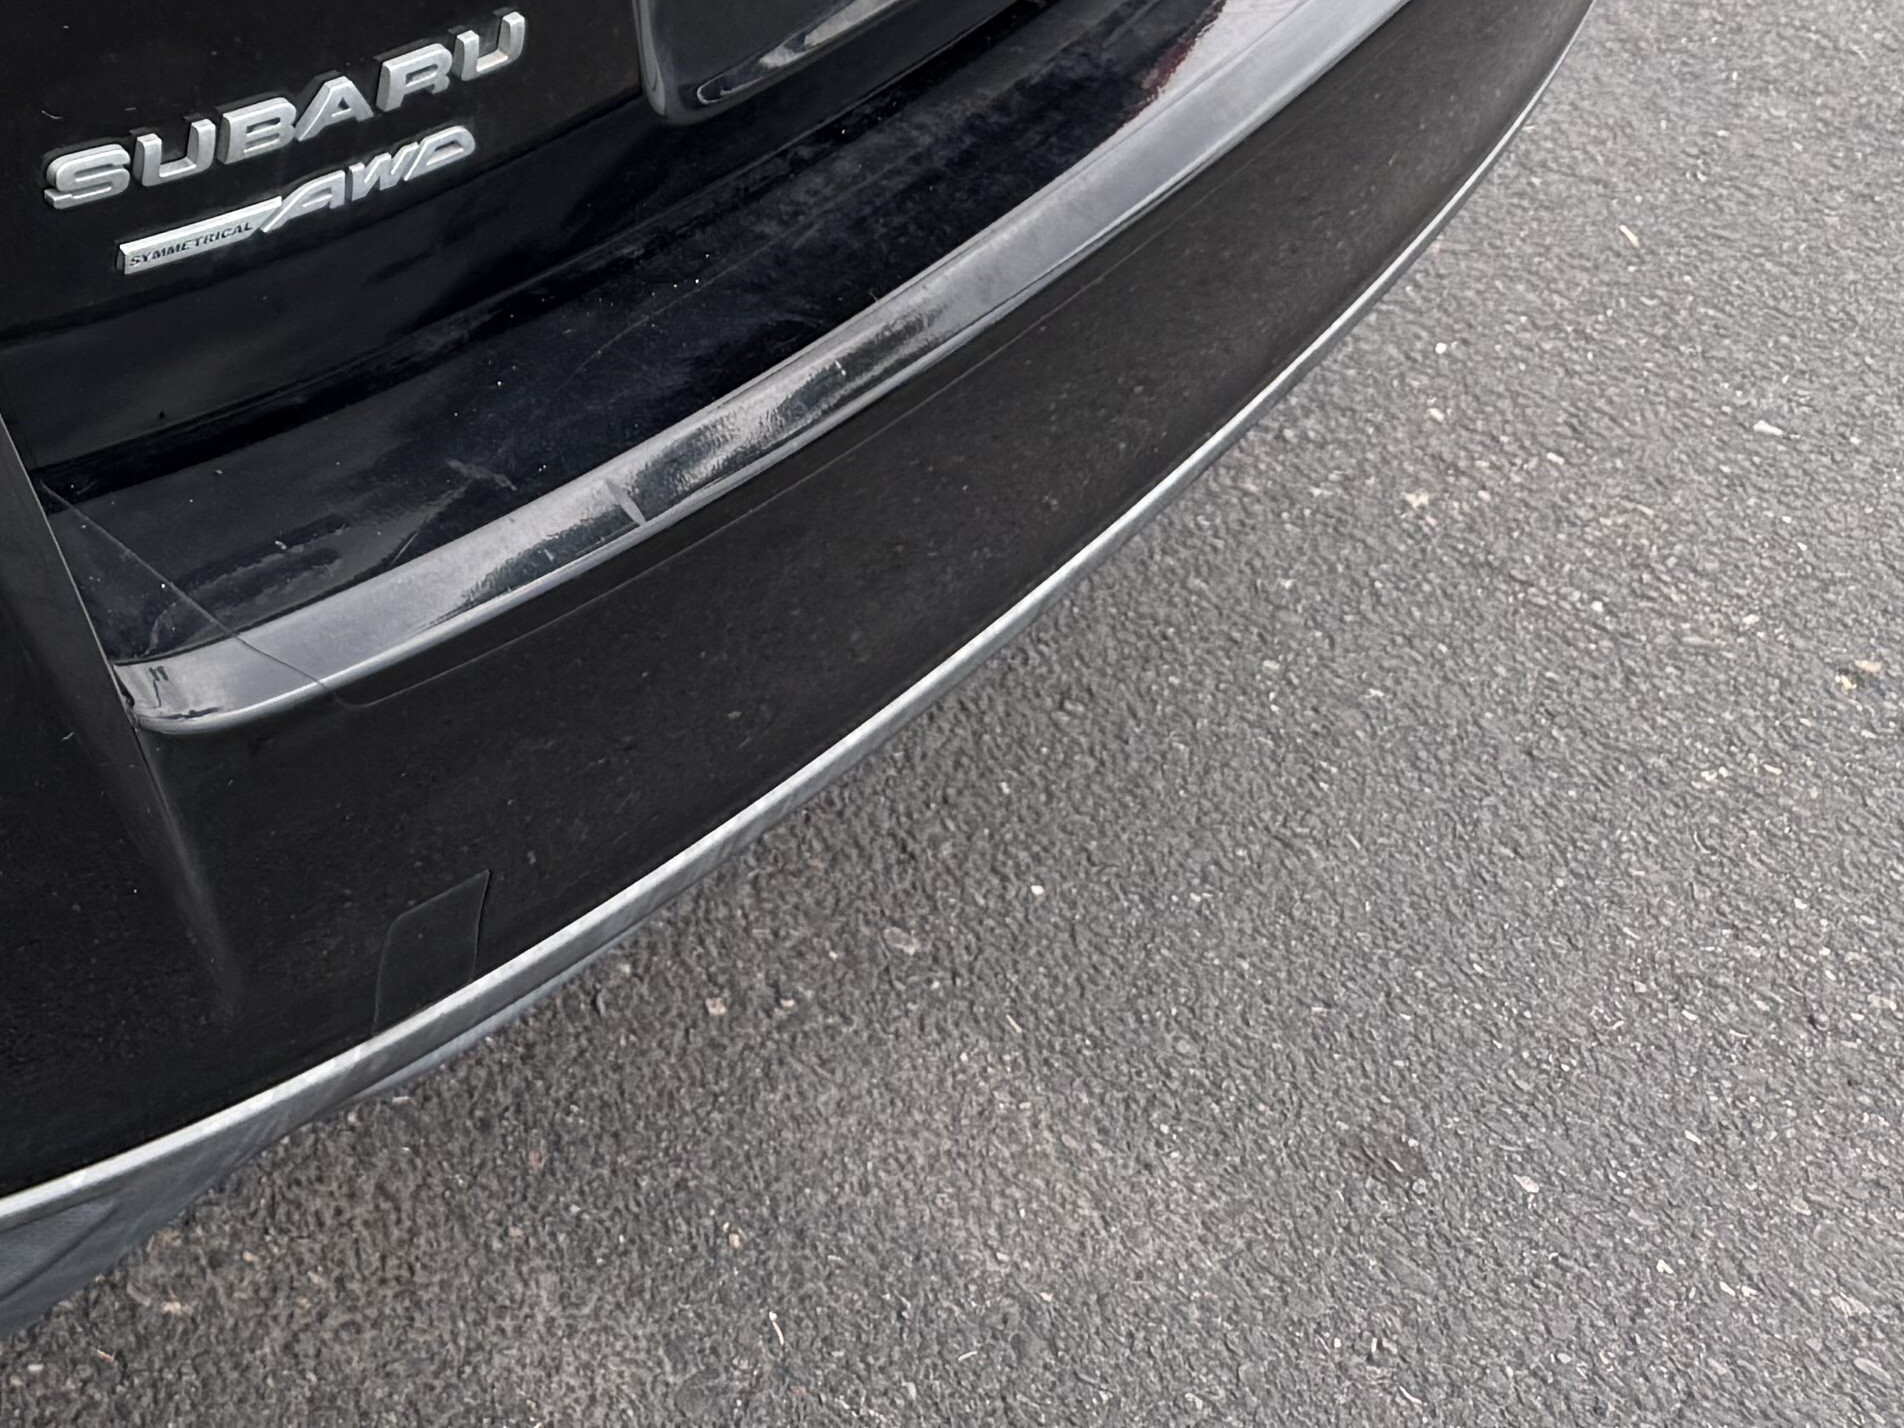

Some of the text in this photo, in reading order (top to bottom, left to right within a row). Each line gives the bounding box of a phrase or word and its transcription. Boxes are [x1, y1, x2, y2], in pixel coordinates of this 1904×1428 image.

[44, 10, 527, 210] SUBARU
[129, 124, 477, 267] SYMMETRICAL AWD
